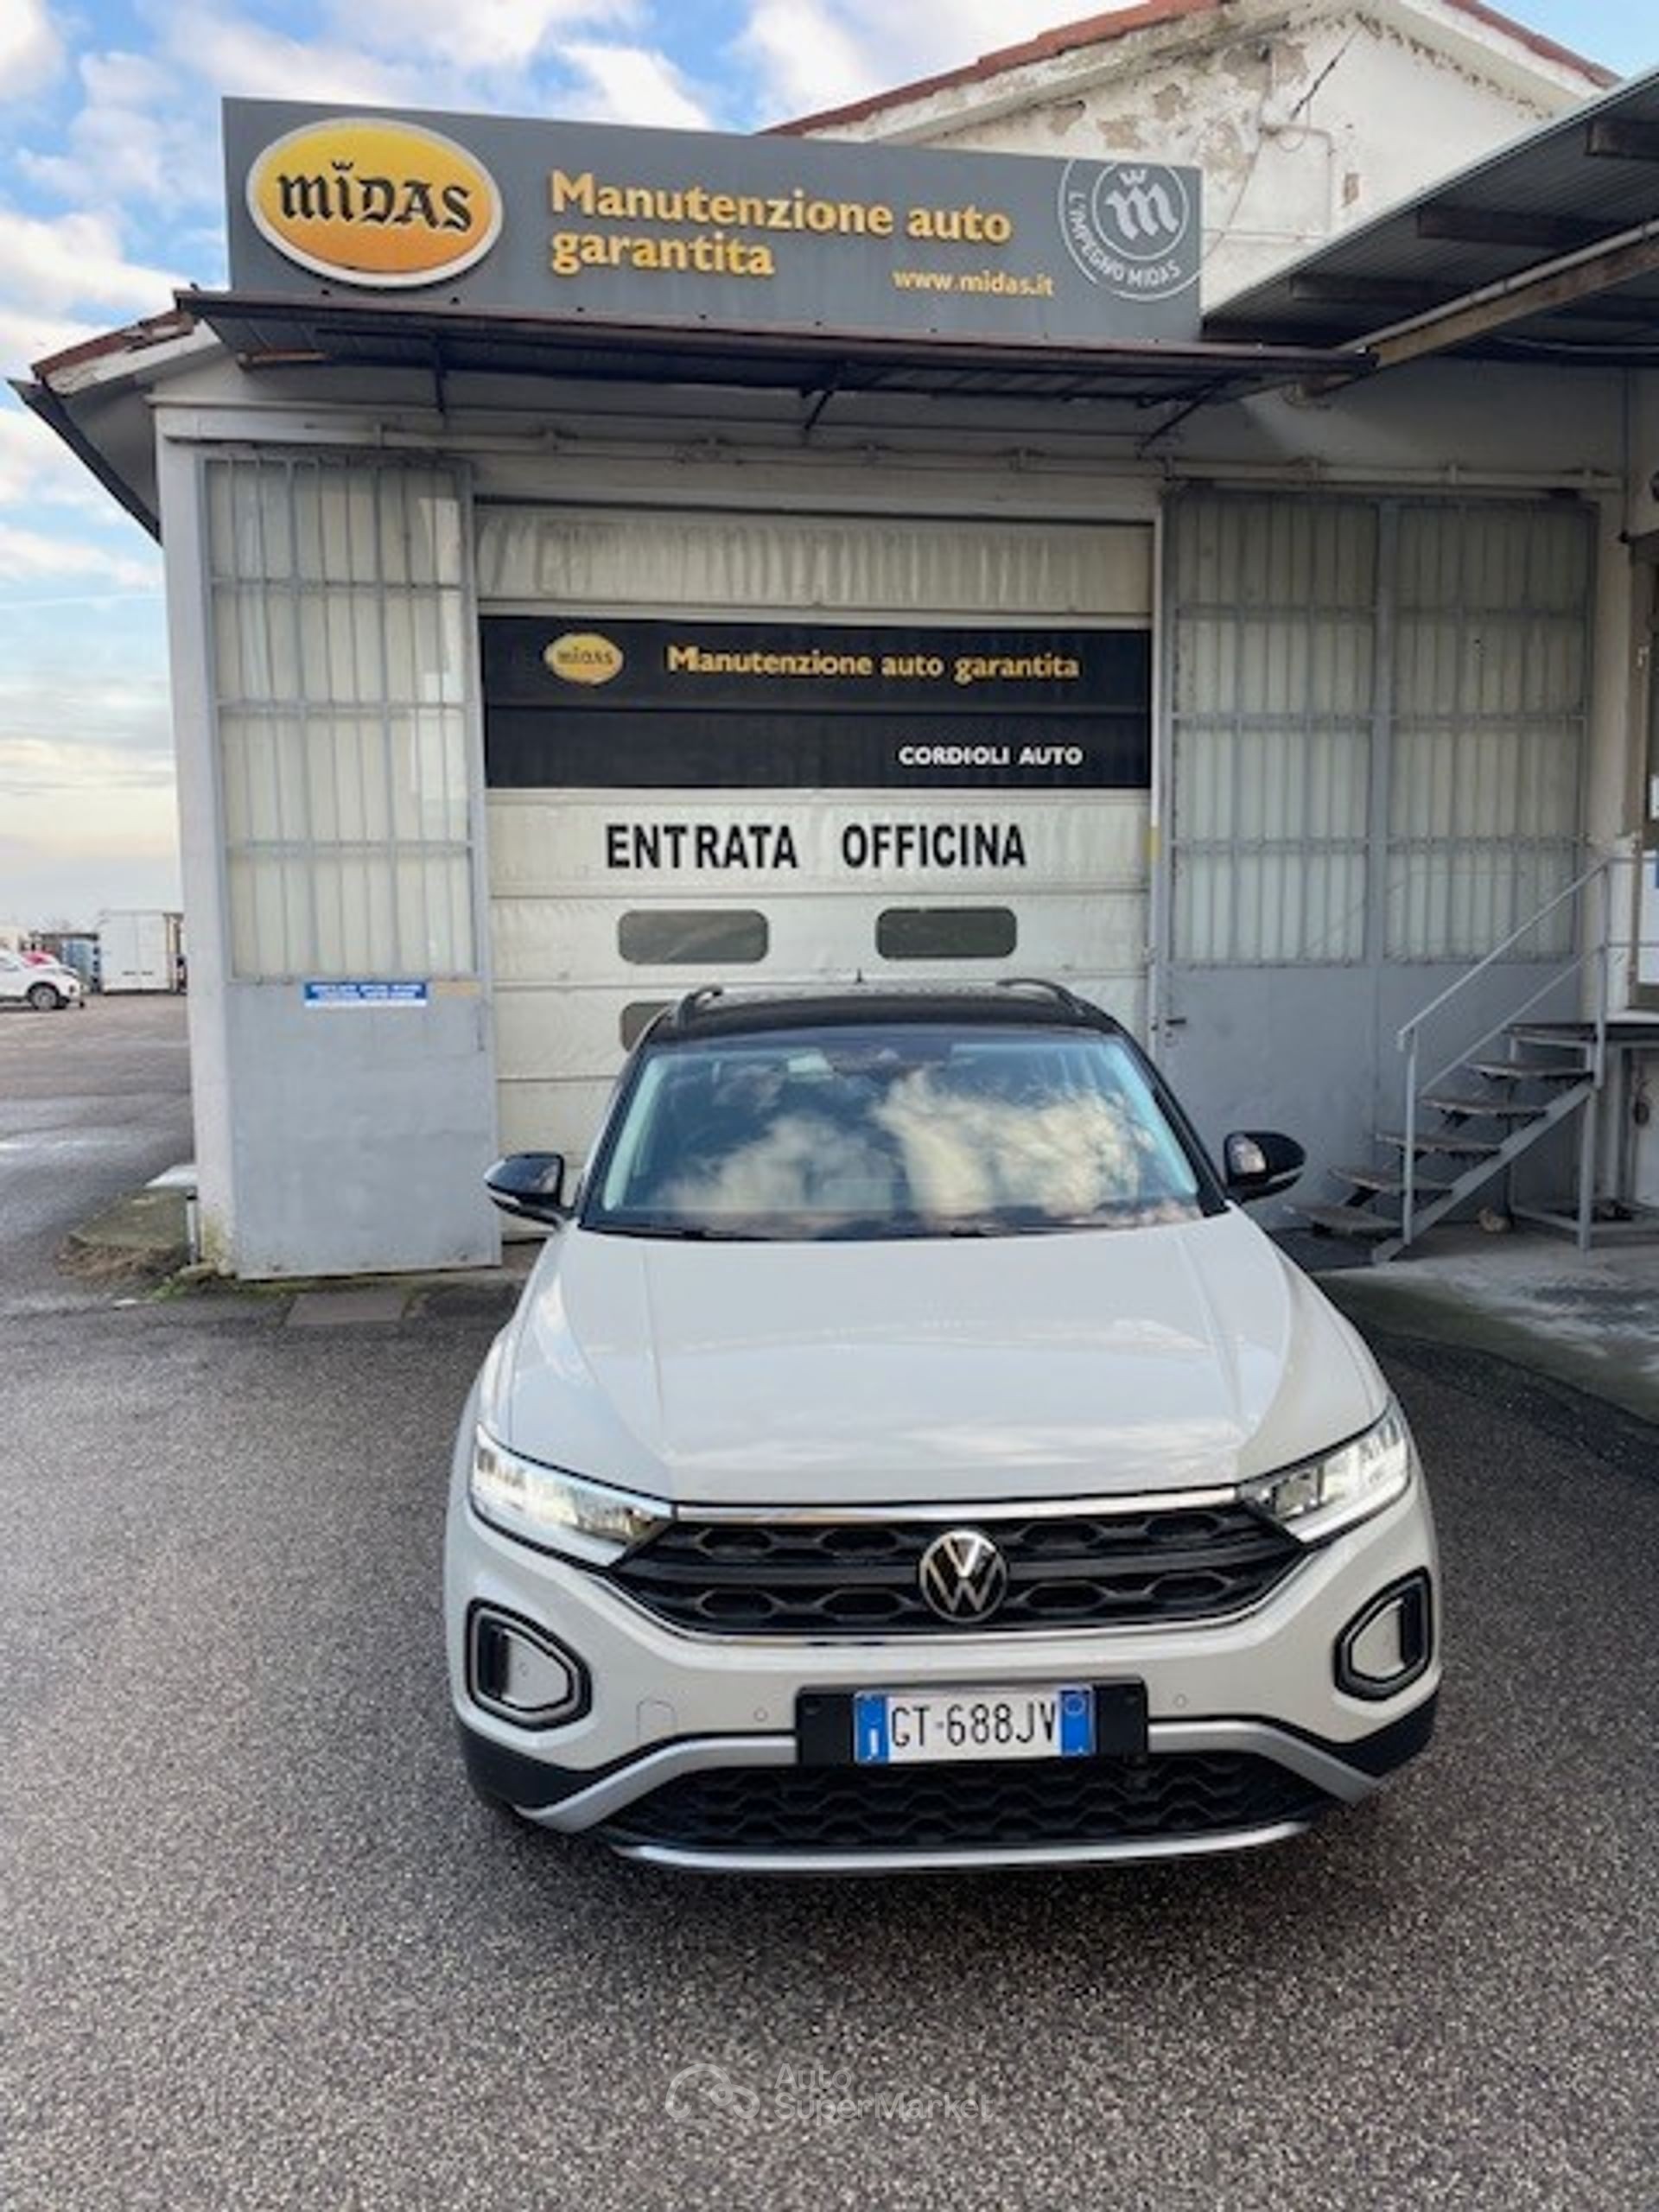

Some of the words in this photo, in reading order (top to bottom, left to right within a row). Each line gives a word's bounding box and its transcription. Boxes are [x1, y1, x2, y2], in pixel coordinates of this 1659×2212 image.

[550, 169, 894, 237] Manutenzione
[906, 203, 1012, 243] auto
[550, 231, 775, 276] garantita
[1127, 260, 1181, 288] MIDAS
[892, 268, 1054, 297] www.midas.it
[667, 645, 874, 677] Manutenzione
[881, 654, 944, 678] auto
[954, 651, 1080, 683] garantita
[899, 745, 1010, 766] CORDIOLI
[1020, 745, 1084, 766] AUTO
[606, 823, 798, 869] ENTRATA
[842, 823, 1026, 868] OFFICINA
[946, 1701, 1056, 1745] 688JV
